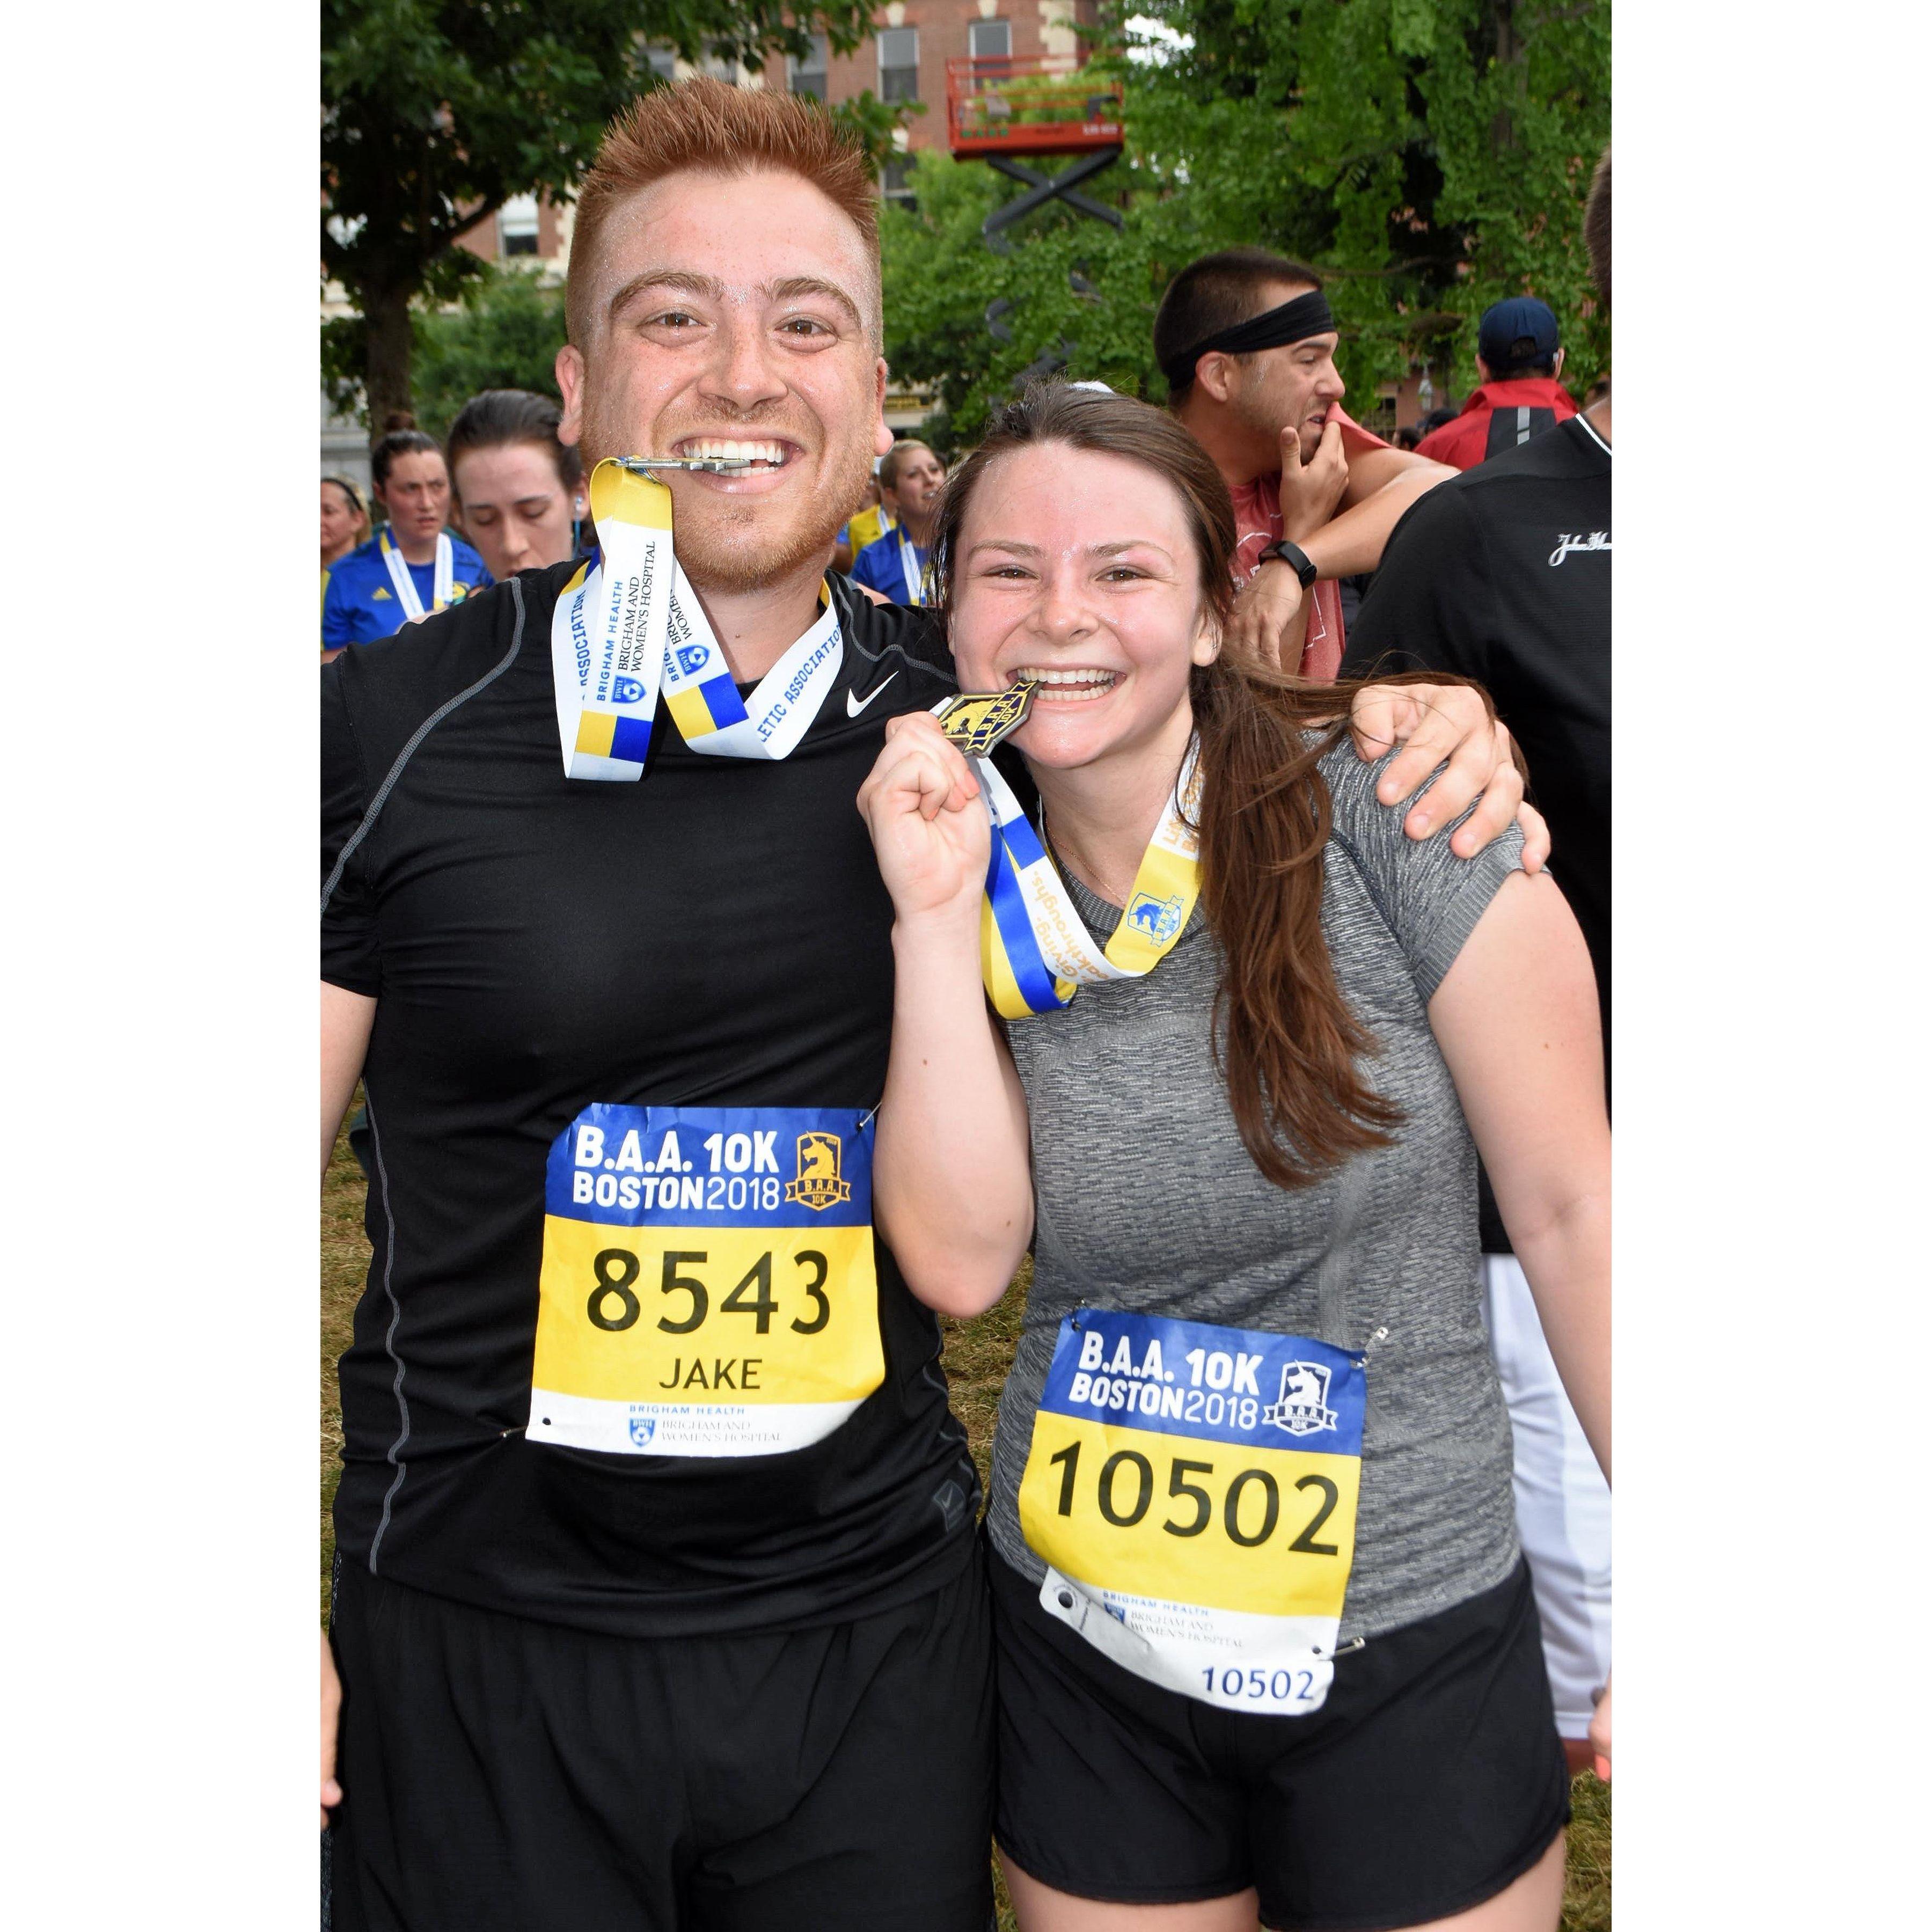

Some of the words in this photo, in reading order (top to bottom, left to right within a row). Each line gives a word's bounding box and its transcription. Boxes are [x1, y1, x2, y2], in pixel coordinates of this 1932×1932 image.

[631, 610, 649, 671] WOMEN'S
[640, 541, 655, 606] HOSPITAL
[618, 609, 637, 670] BRIGHAM
[628, 577, 639, 606] AND
[597, 640, 615, 701] BRIGHAM
[608, 581, 623, 633] HEALTH
[664, 647, 680, 682] BRIG
[679, 652, 692, 671] BWH
[978, 697, 1014, 731] B.A.A.
[1000, 707, 1018, 723] 10K
[1036, 917, 1078, 977] Giving.
[575, 1124, 693, 1173] B.A.A.
[703, 1130, 780, 1174] 10K
[804, 1179, 836, 1191] B.A.A.
[812, 1195, 826, 1204] 10K
[587, 1248, 831, 1335] 8543
[658, 1358, 763, 1390] JAKE
[1078, 1330, 1175, 1383] B.A.A.
[1185, 1348, 1264, 1396] 10K
[629, 1404, 690, 1415] BRIGHAM
[697, 1407, 745, 1415] HEALTH
[662, 1419, 720, 1430] BRIGHAM
[723, 1421, 751, 1430] AND
[661, 1432, 721, 1442] WOMEN'S
[725, 1432, 781, 1442] HOSPITAL
[1050, 1440, 1339, 1556] 10502
[1103, 1590, 1157, 1608] BRIGHAM
[1163, 1602, 1209, 1616] HEALTH
[1131, 1611, 1185, 1627] BRIGHAM
[1190, 1621, 1213, 1631] AND
[1202, 1666, 1314, 1700] 10502
